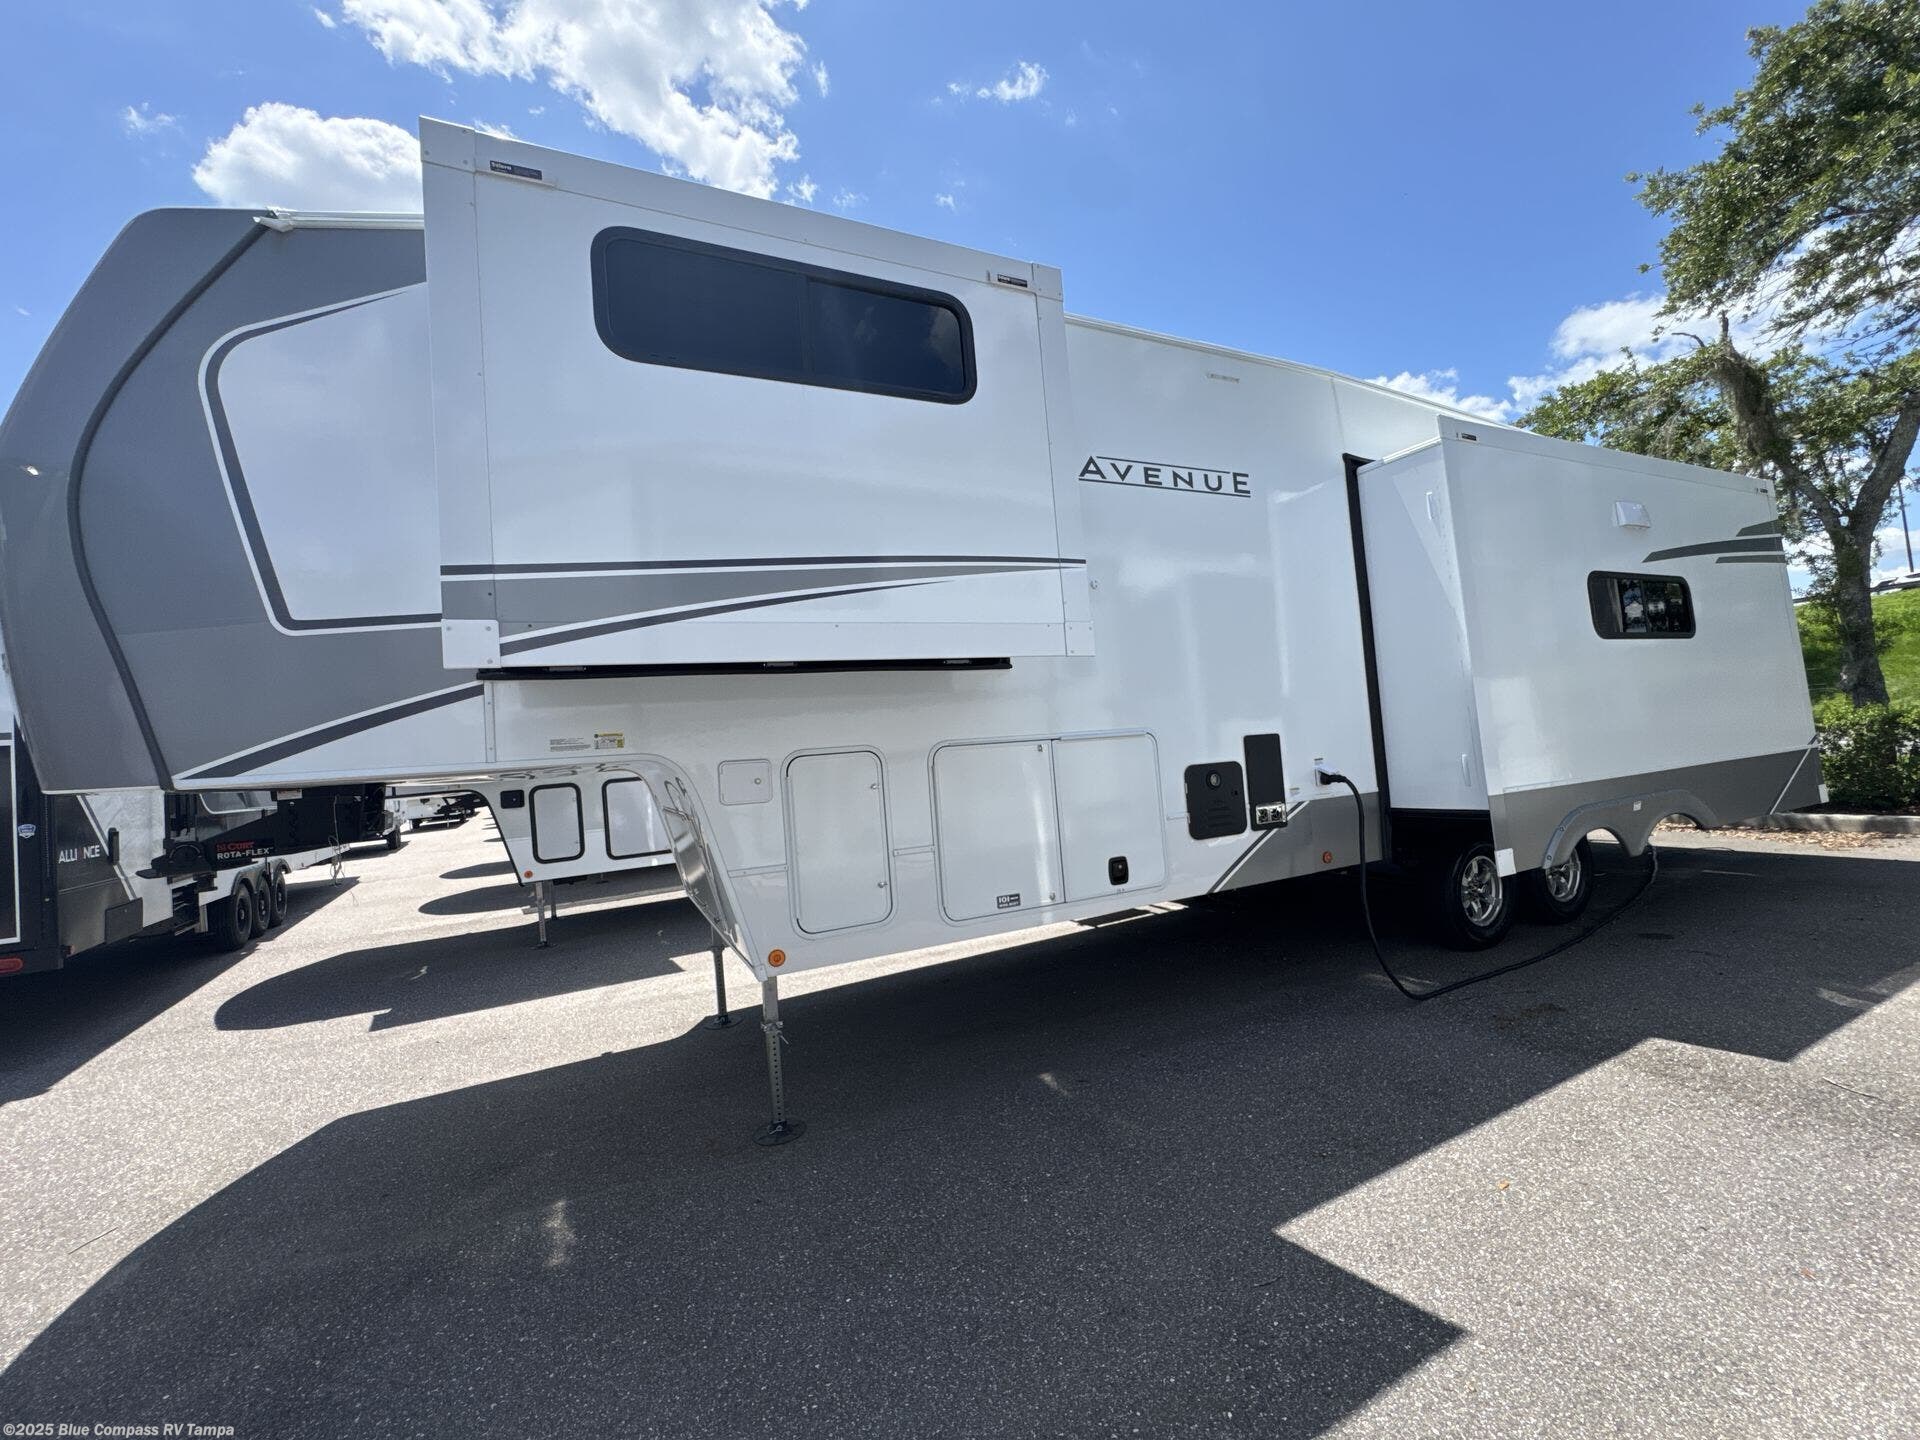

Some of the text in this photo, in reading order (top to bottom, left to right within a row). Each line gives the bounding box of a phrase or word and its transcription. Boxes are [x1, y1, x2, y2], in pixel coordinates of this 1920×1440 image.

[1079, 455, 1251, 495] AVENUE
[58, 845, 101, 864] ALLINCE
[216, 847, 270, 860] ROTA-FLEX
